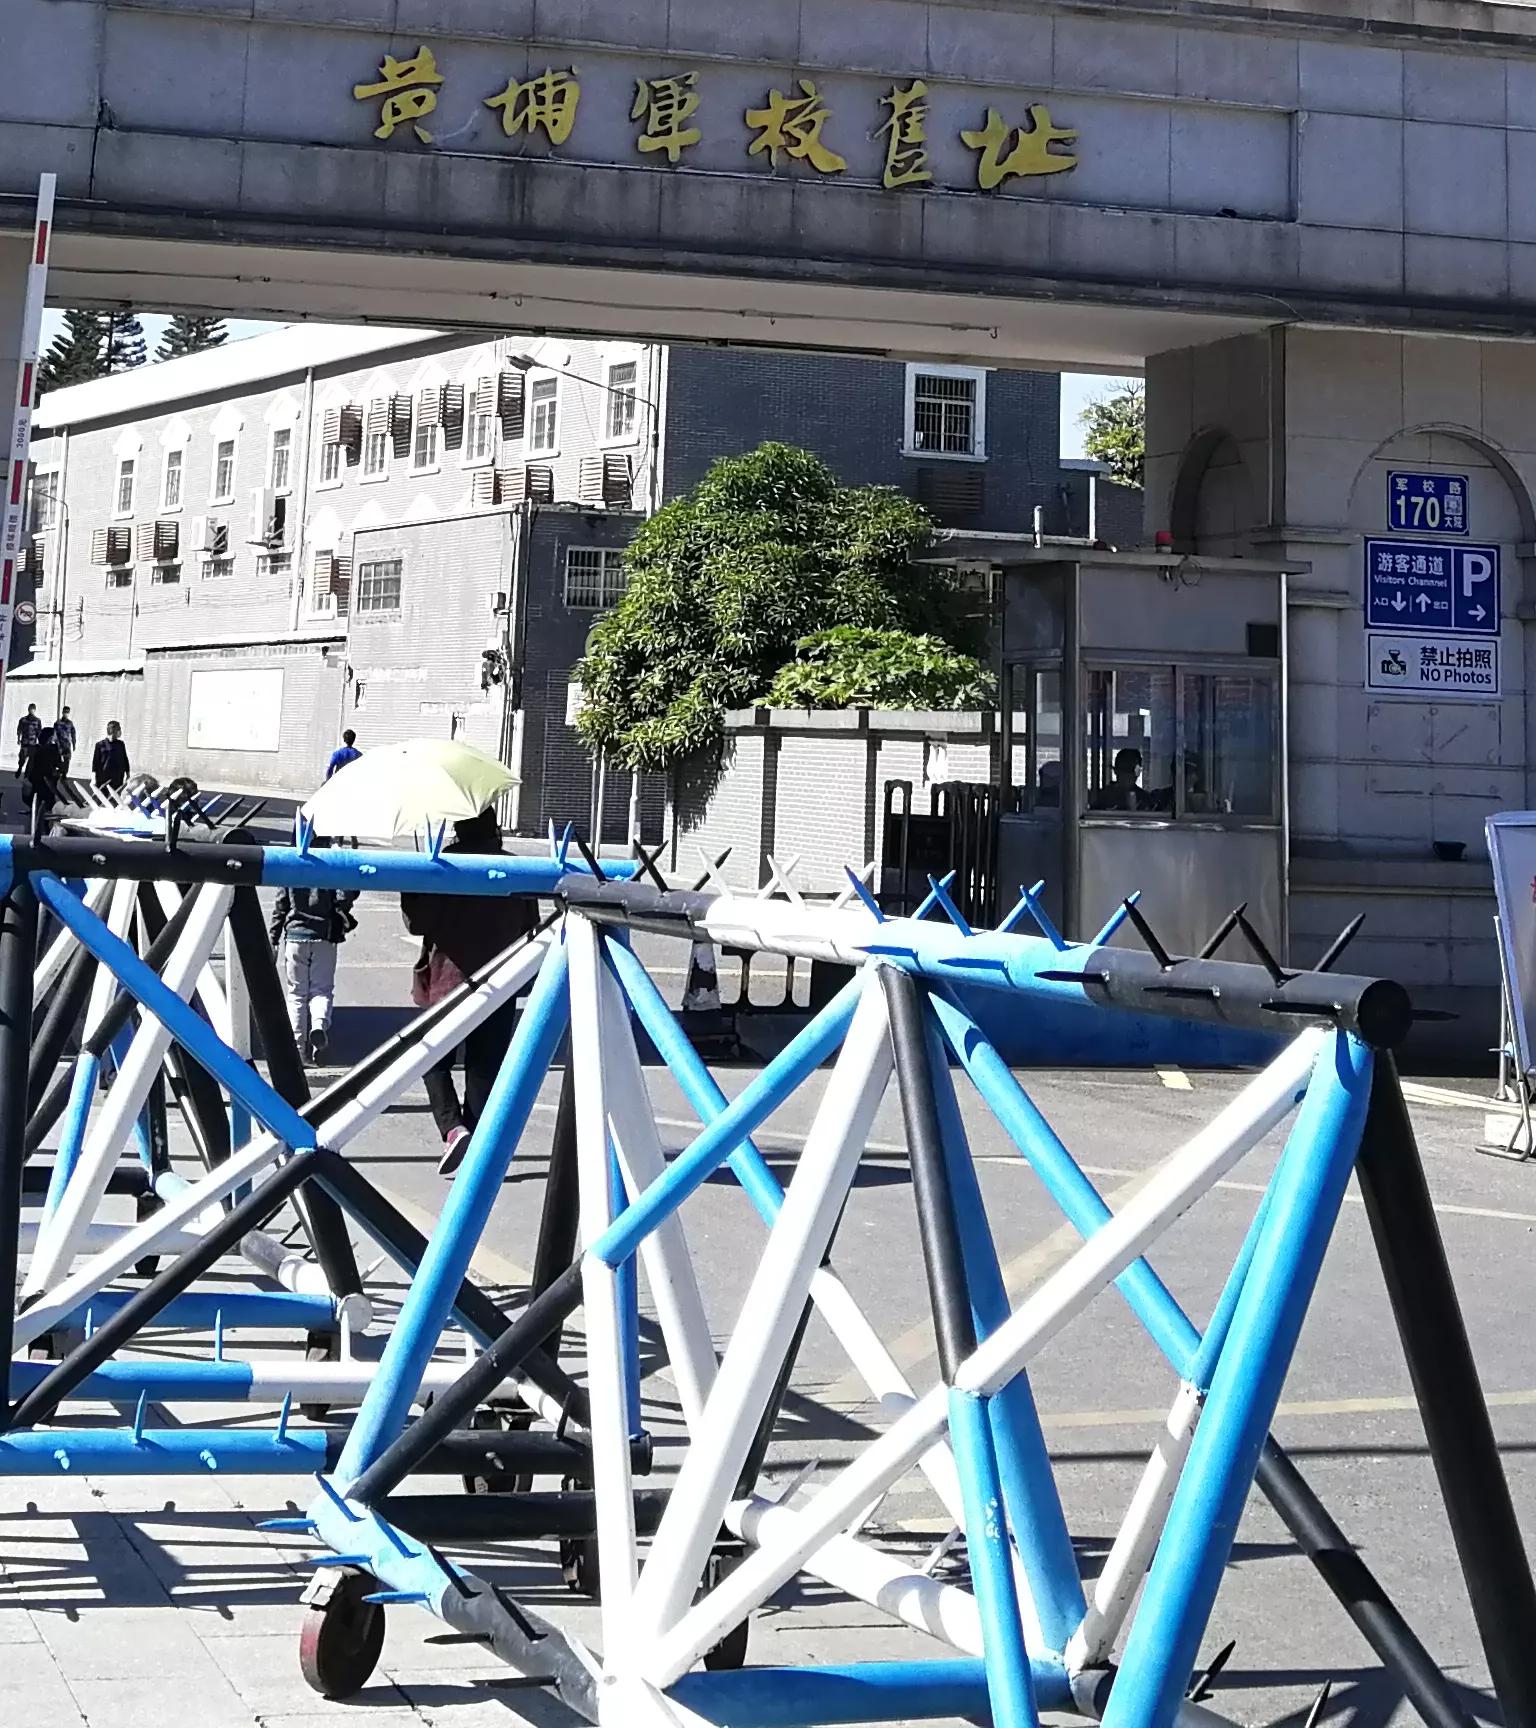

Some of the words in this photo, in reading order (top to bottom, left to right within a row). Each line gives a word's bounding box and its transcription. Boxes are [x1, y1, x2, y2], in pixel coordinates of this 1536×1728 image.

[1396, 494, 1441, 528] 170
[1377, 552, 1444, 576] 游客通道
[1462, 553, 1491, 597] P
[1374, 574, 1406, 586] Visitors
[1373, 597, 1389, 607] 入口
[1420, 646, 1492, 670] 禁止拍照
[1420, 668, 1441, 682] NO
[1444, 670, 1492, 685] Photos
